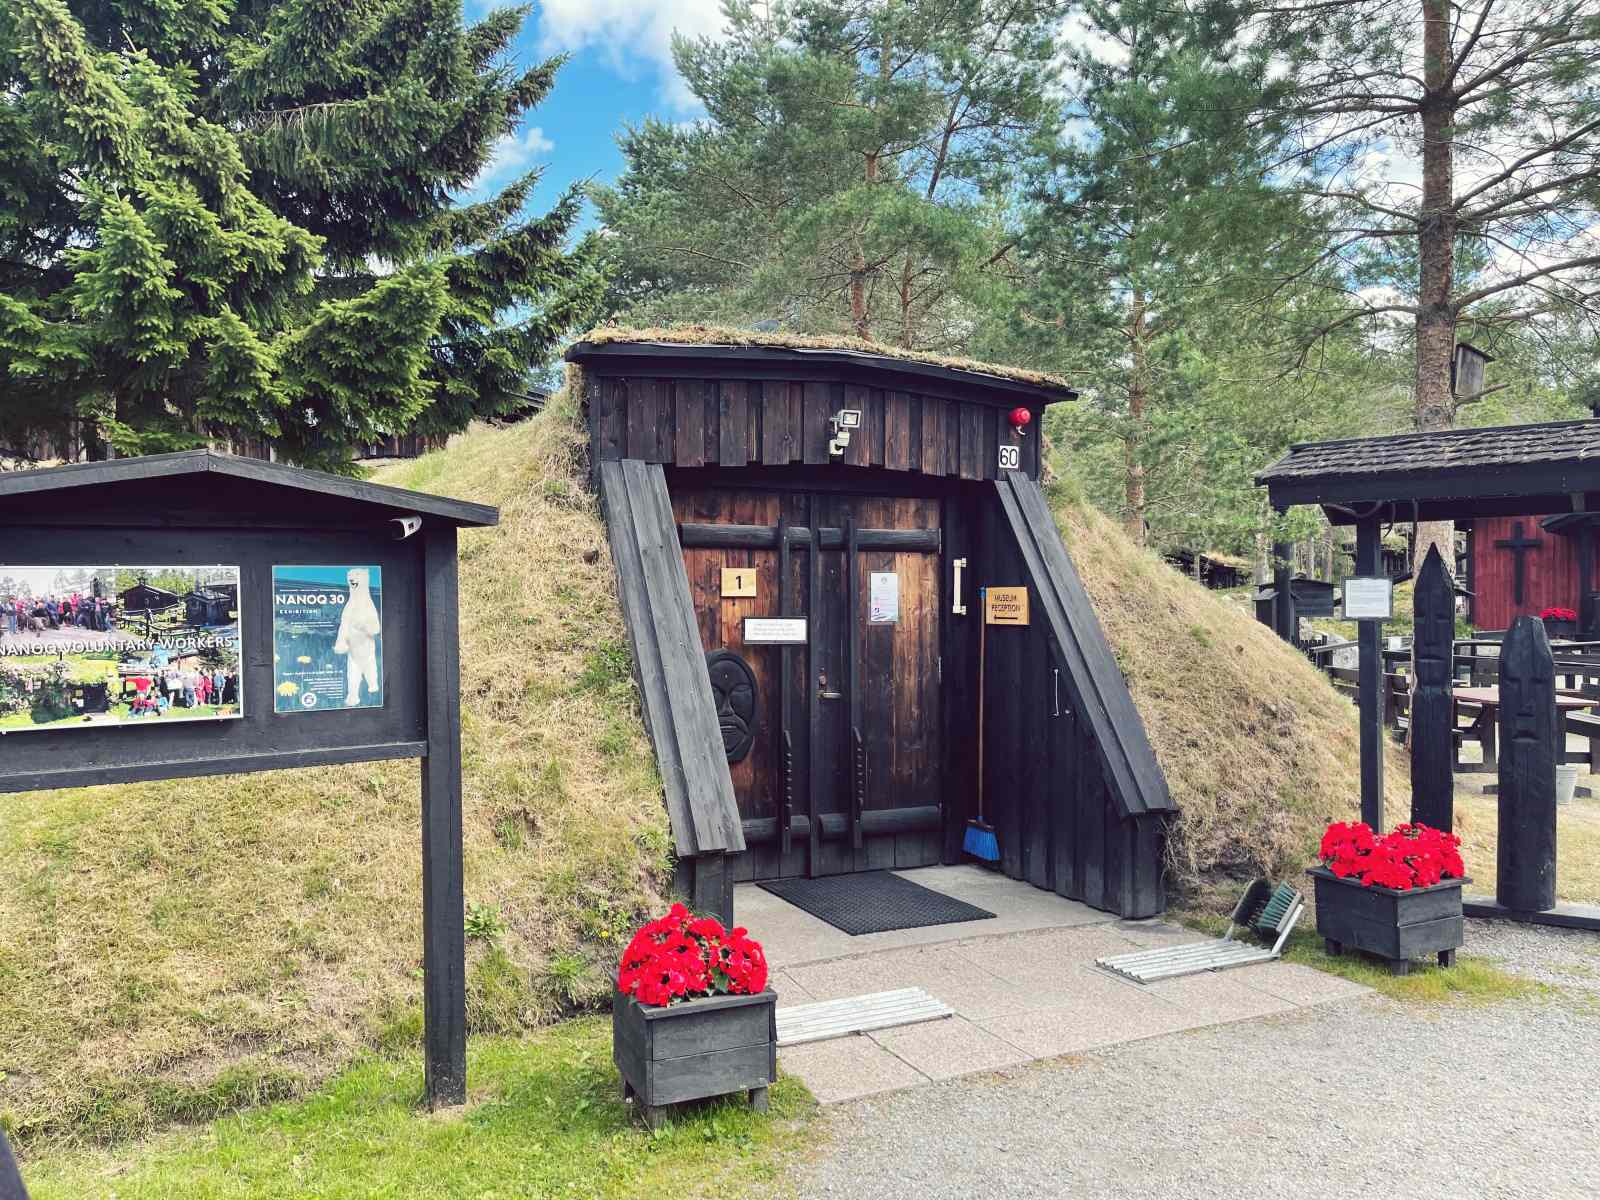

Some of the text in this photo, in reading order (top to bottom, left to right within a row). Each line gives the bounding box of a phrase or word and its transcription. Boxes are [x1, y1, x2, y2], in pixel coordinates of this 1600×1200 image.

[1000, 448, 1017, 466] 60
[736, 575, 742, 590] 1
[276, 594, 345, 605] NANOQ 30
[62, 639, 155, 653] VOLUNTARY
[159, 636, 233, 649] WORKERS
